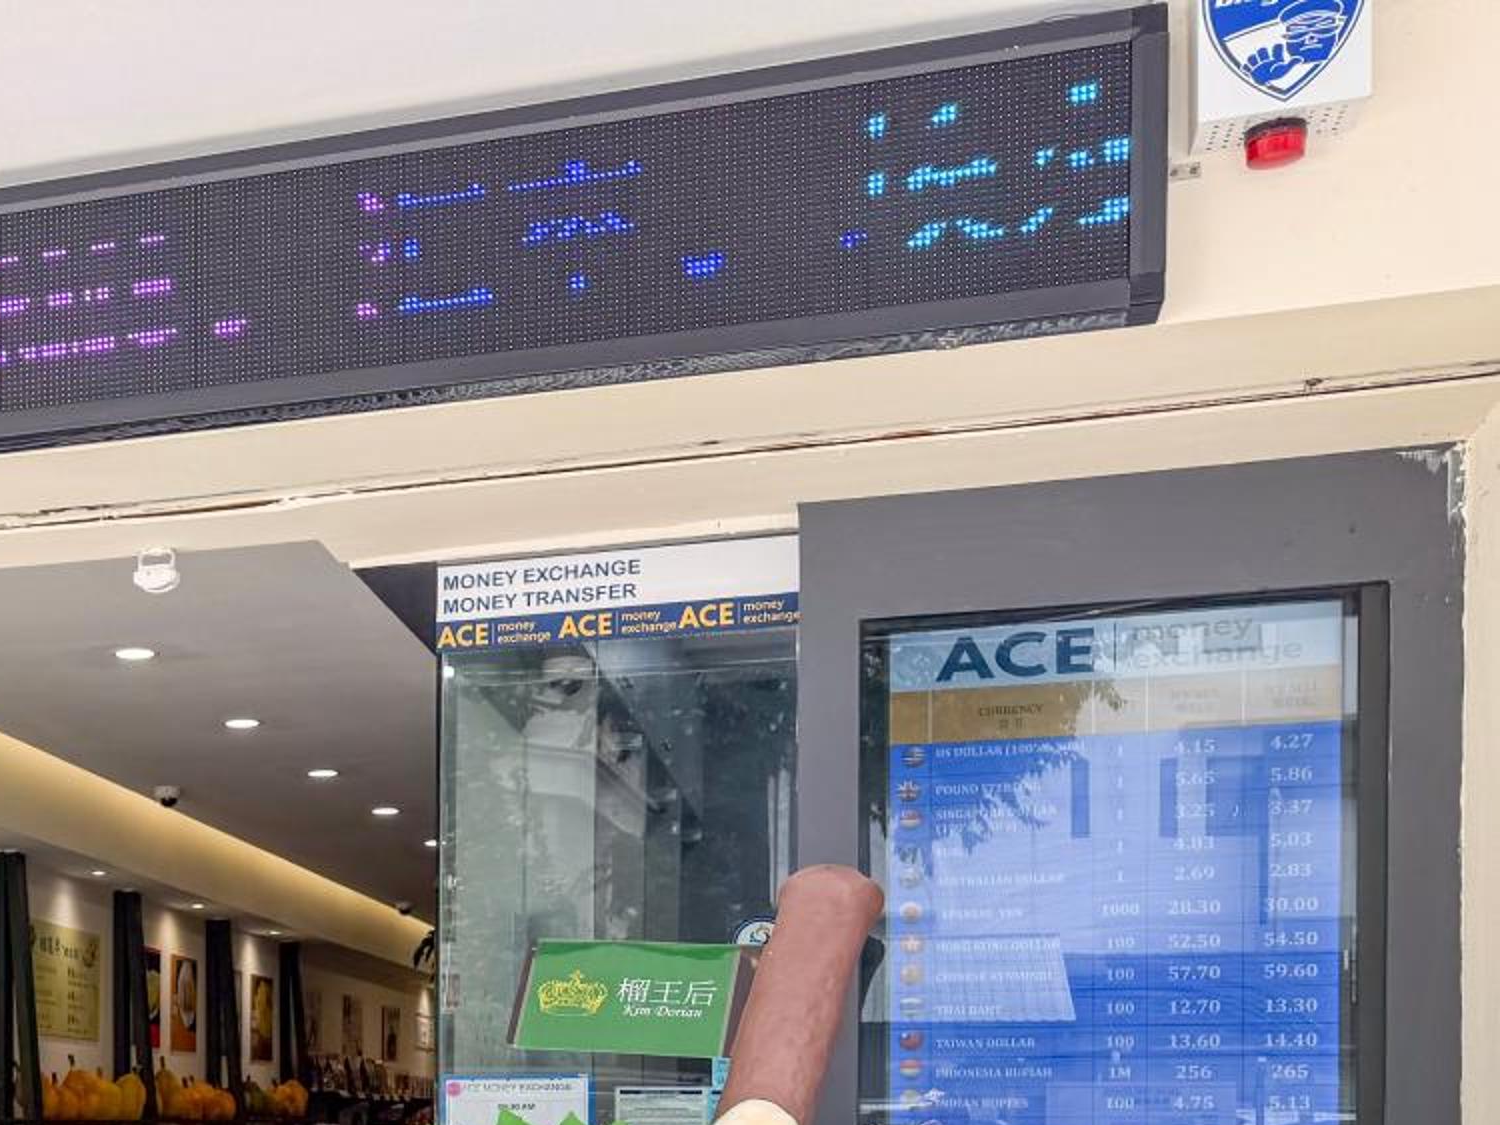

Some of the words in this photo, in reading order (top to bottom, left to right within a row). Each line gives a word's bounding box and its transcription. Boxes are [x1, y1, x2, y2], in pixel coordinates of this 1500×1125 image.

[443, 570, 517, 591] MONEY
[523, 559, 642, 584] EXCHANGE
[443, 593, 517, 614] MONEY
[523, 583, 637, 607] TRANSFER
[678, 602, 735, 630] ACE
[743, 600, 785, 611] money
[558, 612, 613, 640] ACE
[621, 610, 661, 622] money
[621, 621, 677, 634] exchange
[436, 623, 488, 649] ACE
[498, 620, 536, 632] money
[498, 631, 551, 644] exchange
[935, 627, 1095, 682] ACE
[1132, 616, 1252, 645] money
[1270, 734, 1314, 750] 4.27
[935, 783, 978, 795] POUND
[1271, 768, 1313, 782] 5.86
[1271, 832, 1313, 847] 5.03
[1266, 897, 1319, 912] 30.00
[1264, 931, 1317, 947] 54.50
[1107, 967, 1135, 982] 100
[1168, 965, 1221, 980] 57.70
[1264, 963, 1318, 978] 59.60
[615, 977, 718, 1006] 榴王后
[1106, 1001, 1135, 1016] 100
[1169, 1000, 1221, 1015] 12.70
[1266, 998, 1318, 1013] 13.30
[1106, 1035, 1135, 1049] 100
[1169, 1034, 1221, 1048] 13.60
[1265, 1032, 1318, 1047] 14.40
[1108, 1066, 1131, 1079] 1M
[1174, 1065, 1213, 1080] 256
[1270, 1064, 1310, 1079] 265
[1106, 1095, 1135, 1110] 100
[1172, 1095, 1215, 1110] 4.75
